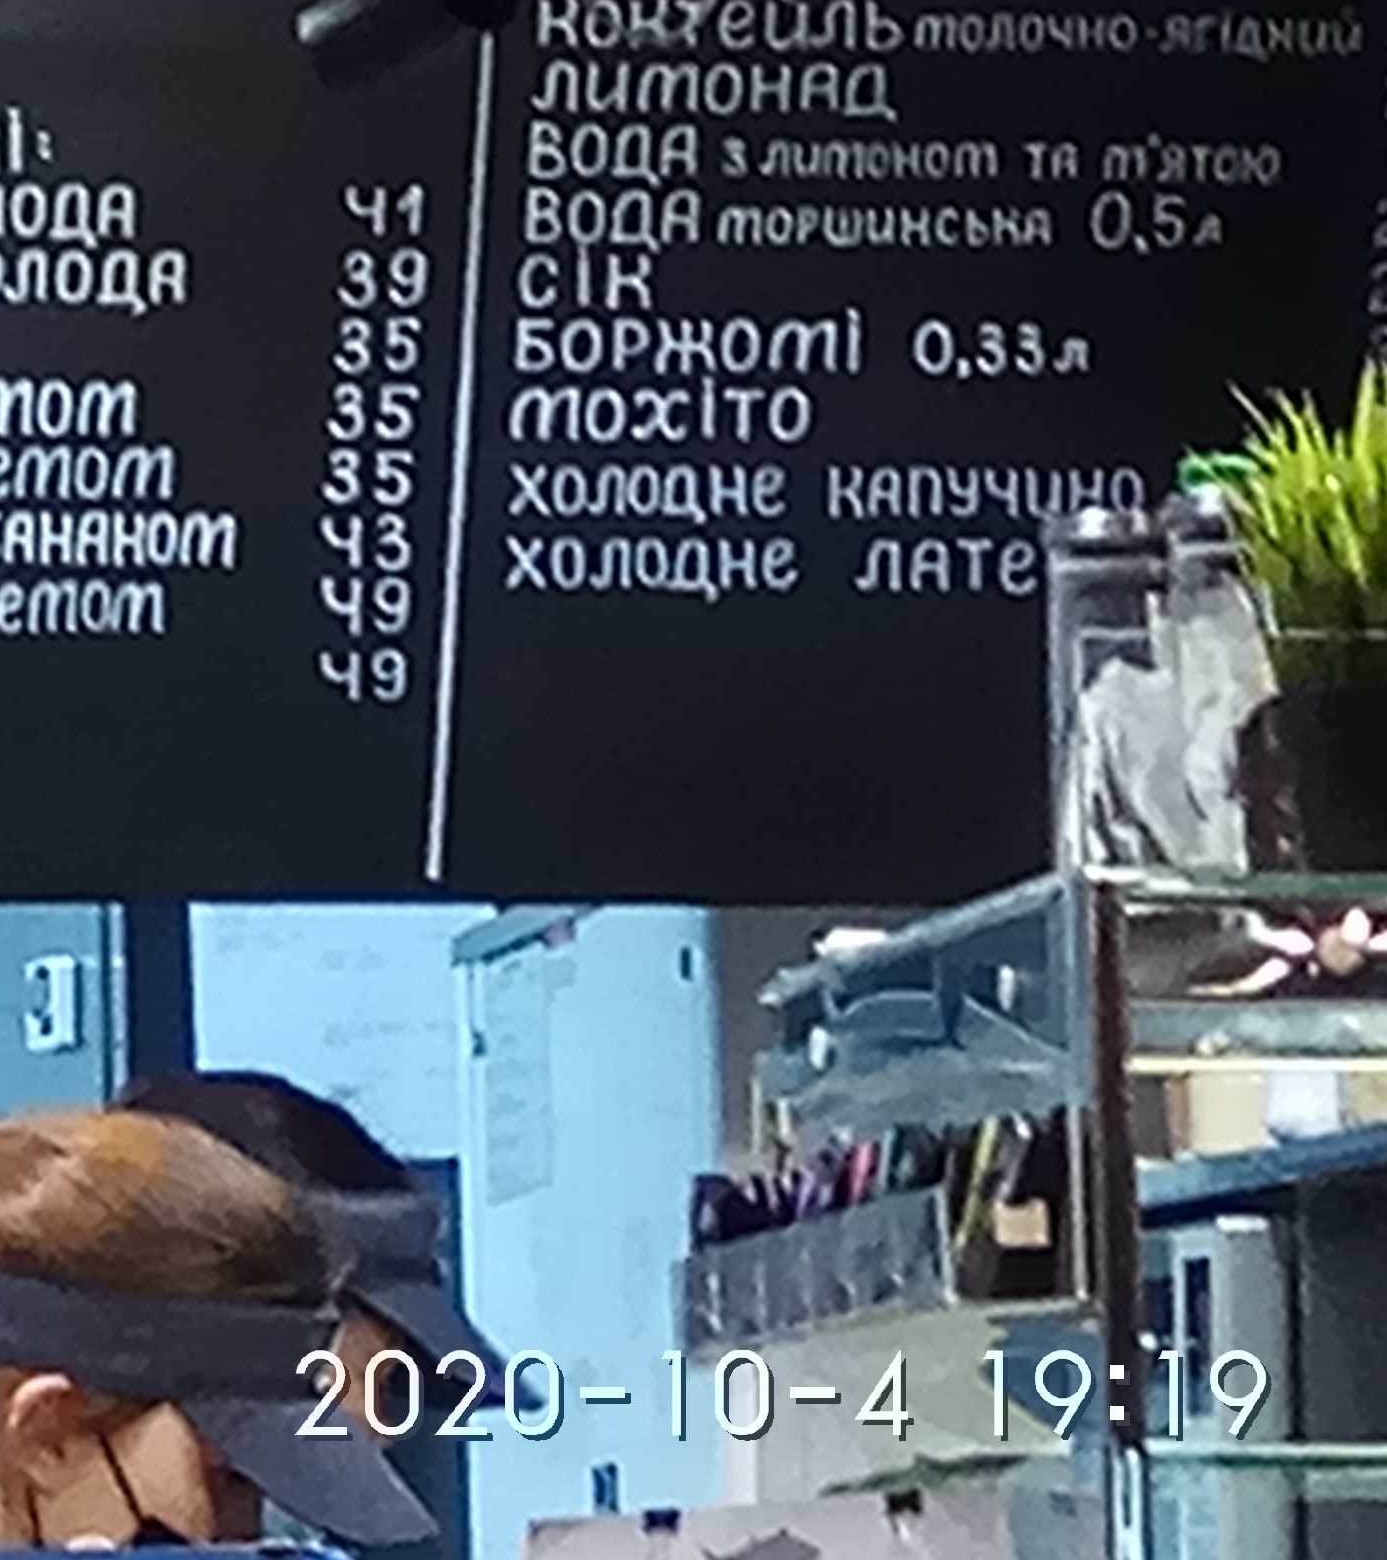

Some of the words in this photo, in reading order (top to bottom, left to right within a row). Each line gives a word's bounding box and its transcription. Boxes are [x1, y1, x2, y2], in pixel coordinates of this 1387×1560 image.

[530, 58, 898, 122] ЛИМОНАД
[527, 119, 698, 188] ВОДА
[344, 183, 425, 237] 41
[524, 185, 701, 257] ВОДА
[337, 248, 428, 310] 39
[517, 245, 652, 311] СІК
[333, 315, 422, 375] 35
[513, 307, 861, 376] БОРЖОМІ
[326, 382, 421, 441] 35
[508, 376, 811, 443] МОХІТО
[322, 447, 415, 506] 35
[508, 463, 785, 525] ХОЛОДНЕ
[827, 465, 1146, 518] КАПУЧИНО
[320, 511, 412, 573] 43
[505, 535, 799, 602] ХОЛОДНЕ
[854, 537, 1038, 595] ЛАТЕ
[319, 575, 411, 637] 49
[319, 647, 408, 702] 49
